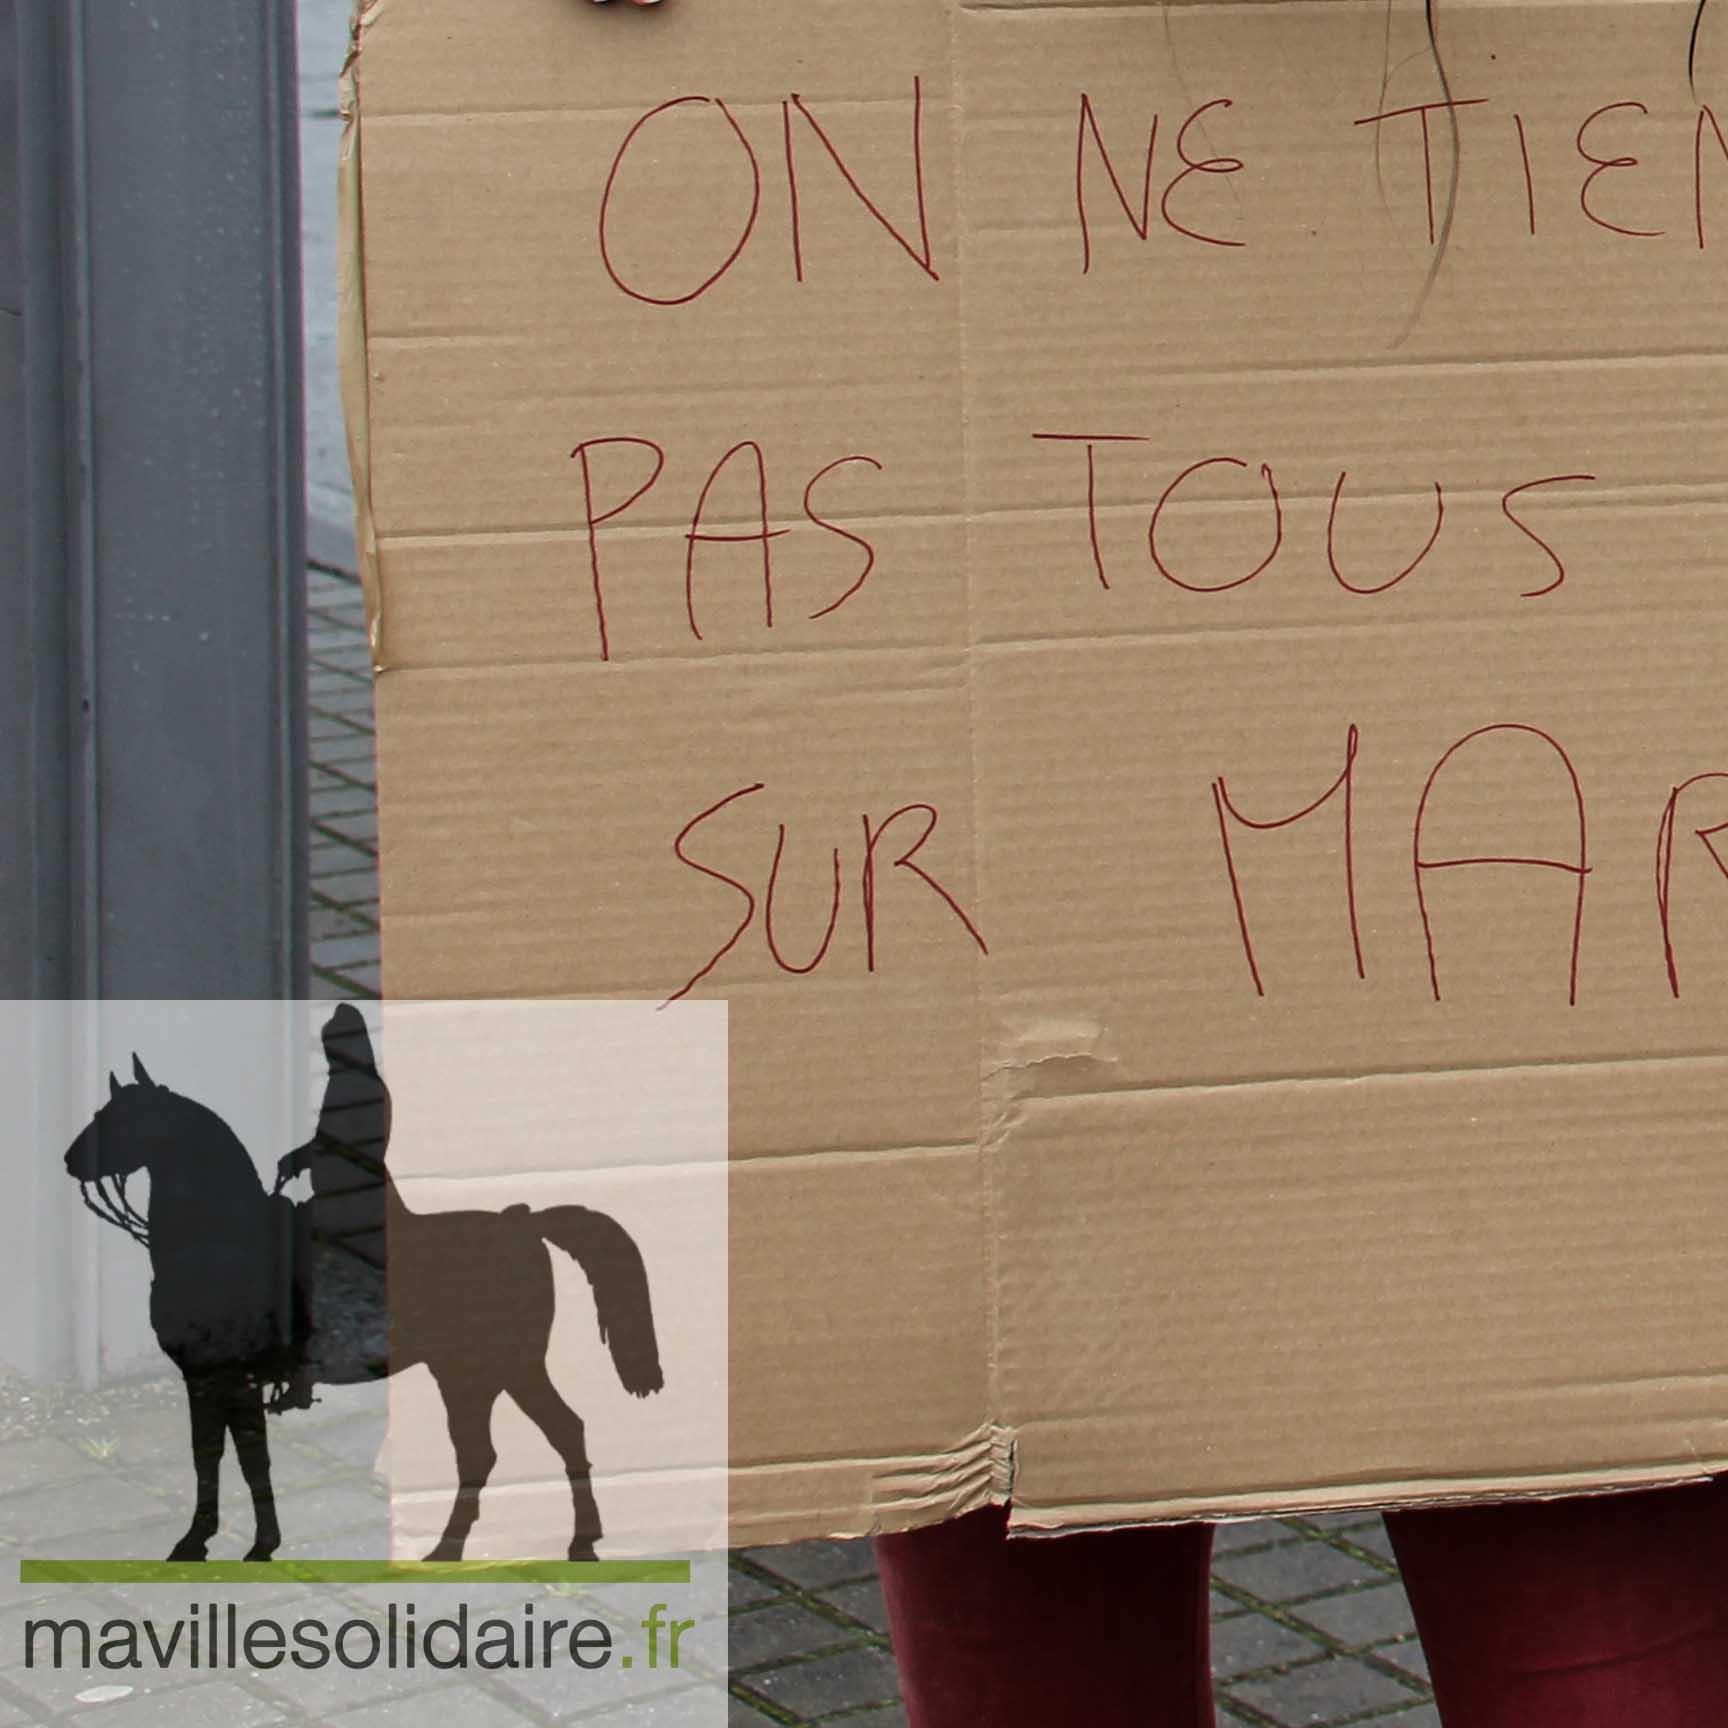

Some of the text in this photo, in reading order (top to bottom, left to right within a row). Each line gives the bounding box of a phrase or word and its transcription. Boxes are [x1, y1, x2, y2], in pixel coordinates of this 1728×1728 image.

[599, 75, 939, 305] ON
[1077, 93, 1246, 273] NE
[570, 434, 1596, 661] PAS TOUS
[655, 783, 989, 1010] SUR
